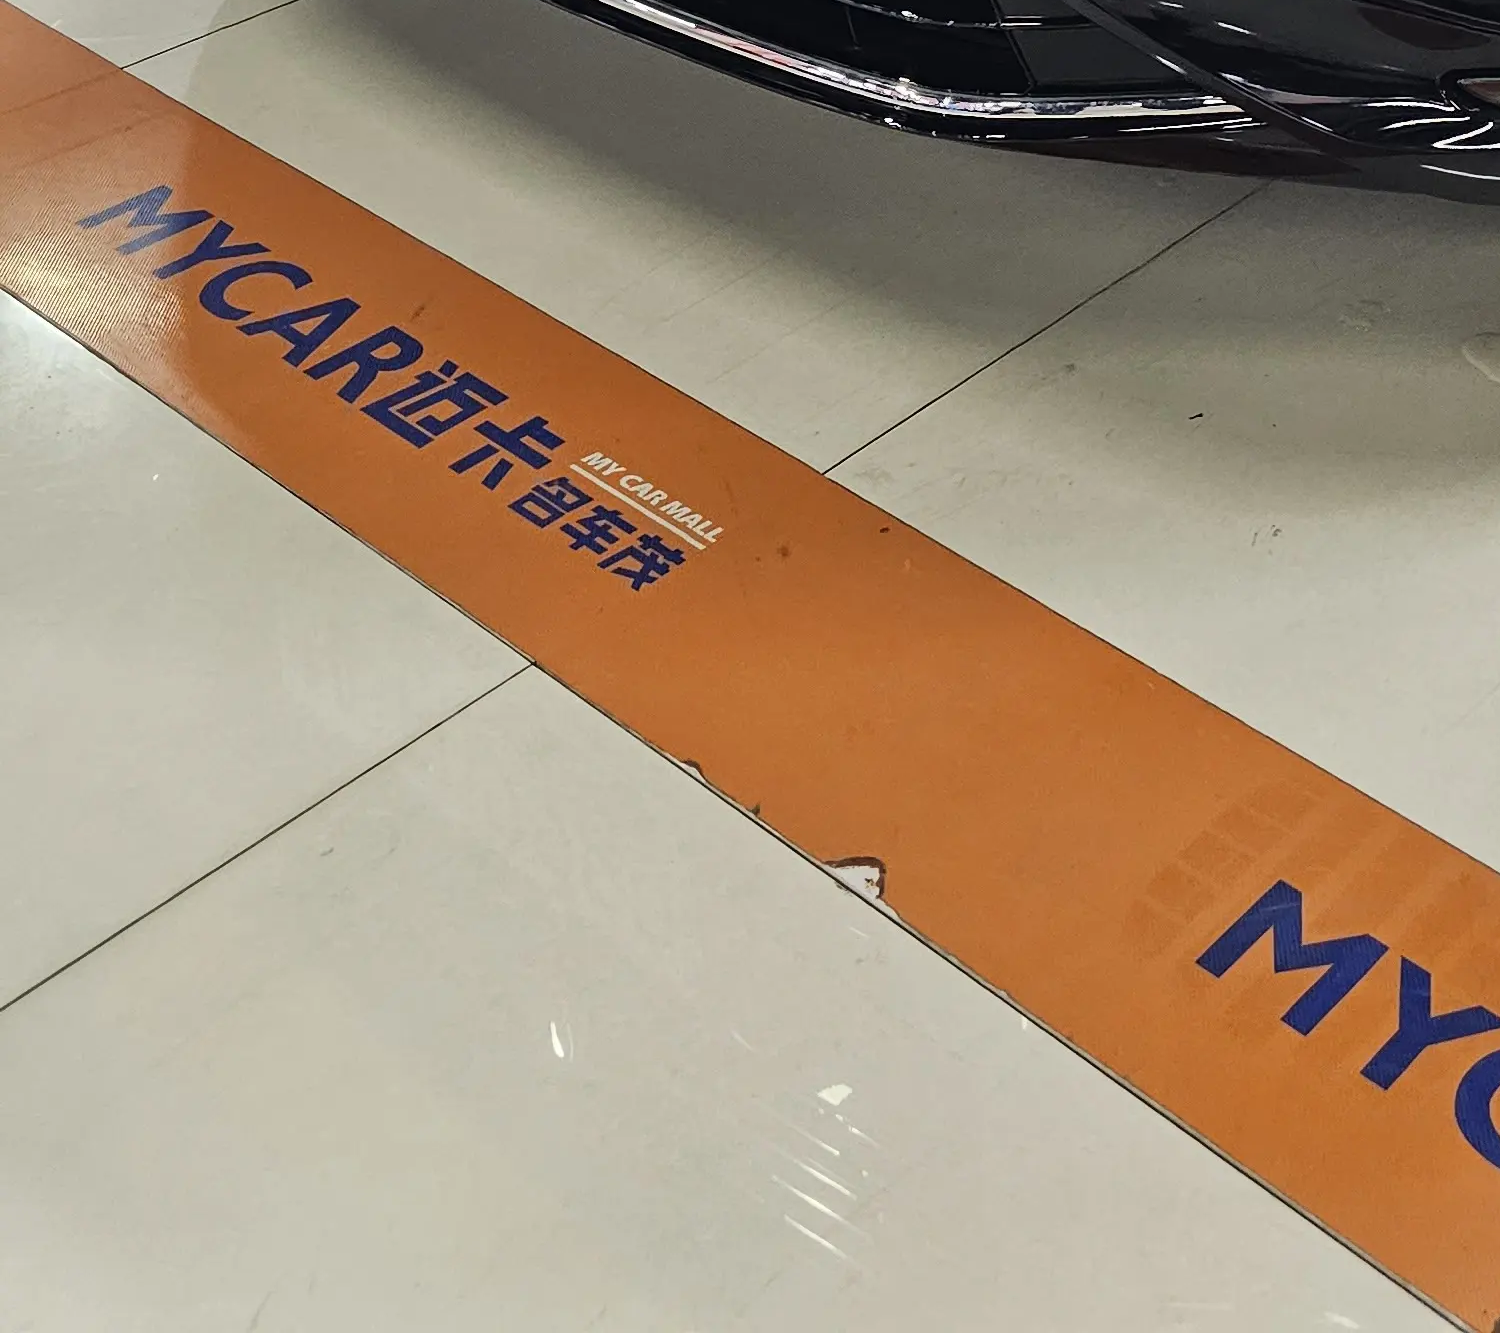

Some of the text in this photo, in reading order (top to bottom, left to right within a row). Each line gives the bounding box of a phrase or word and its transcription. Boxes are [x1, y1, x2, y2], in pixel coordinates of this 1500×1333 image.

[507, 476, 687, 591] 名车茂
[580, 451, 724, 543] MY CAR MALL
